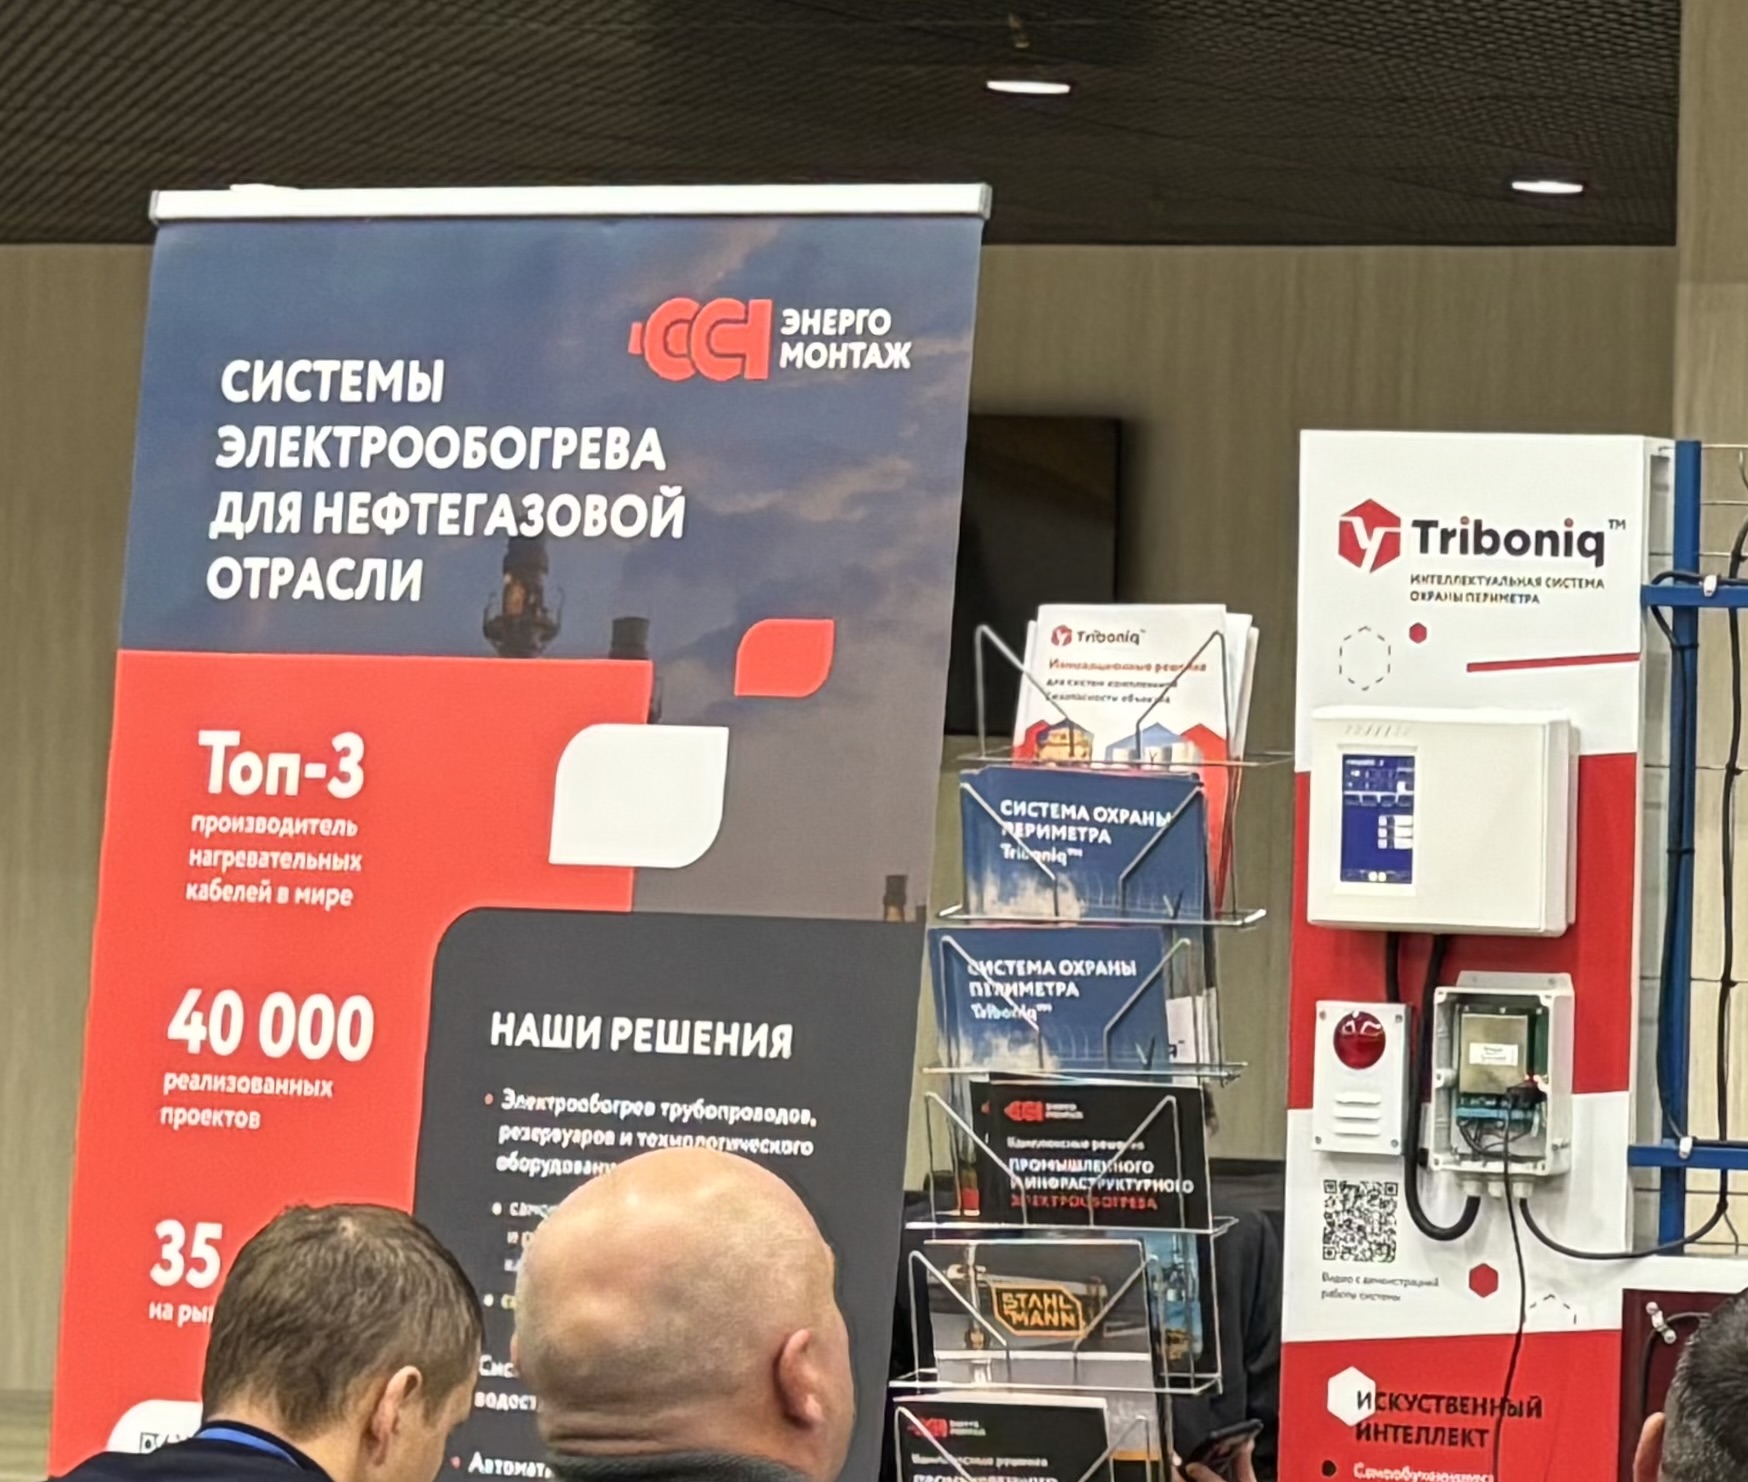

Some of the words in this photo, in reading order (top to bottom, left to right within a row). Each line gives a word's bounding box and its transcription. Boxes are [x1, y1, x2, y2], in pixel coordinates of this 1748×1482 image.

[780, 308, 892, 336] ЭНЕРГО
[779, 341, 912, 369] МОНТАЖ
[220, 358, 446, 403] СИСТЕМЫ
[215, 424, 667, 471] ЭЛЕКТРООБОГРЕВА
[208, 490, 301, 540] ДЛЯ
[312, 485, 686, 539] НЕФТЕГАЗОВОЙ
[205, 555, 425, 602] ОТРАСЛИ
[1545, 576, 1606, 590] СИСТЕМА
[198, 729, 365, 800] Топ-3
[190, 813, 359, 839] производитель
[1000, 799, 1090, 822] СИСТЕМА
[1093, 806, 1172, 828] ОХРАНЫ
[1001, 821, 1112, 845] ПЕРИМЕТРА
[188, 848, 363, 875] нагревательных
[185, 877, 272, 904] кабелей
[277, 886, 290, 905] в
[294, 886, 354, 912] мире
[967, 959, 1057, 977] СИСТЕМА
[1059, 959, 1138, 977] ОХРАНЫ
[167, 987, 245, 1057] 40
[258, 990, 375, 1062] 000
[490, 1011, 602, 1050] НАШИ
[610, 1016, 793, 1060] РЕШЕНИЯ
[163, 1071, 334, 1099] реализованных
[160, 1105, 261, 1131] проектов
[619, 1131, 633, 1147] и
[149, 1218, 223, 1290] 35
[149, 1301, 174, 1321] на
[1001, 1292, 1073, 1310] STAHL
[1005, 1309, 1077, 1328] MANN
[1356, 1389, 1543, 1419] ИСКУСТВЕННЫЙ
[1355, 1422, 1490, 1448] ИНТЕЛЛЕКТ
